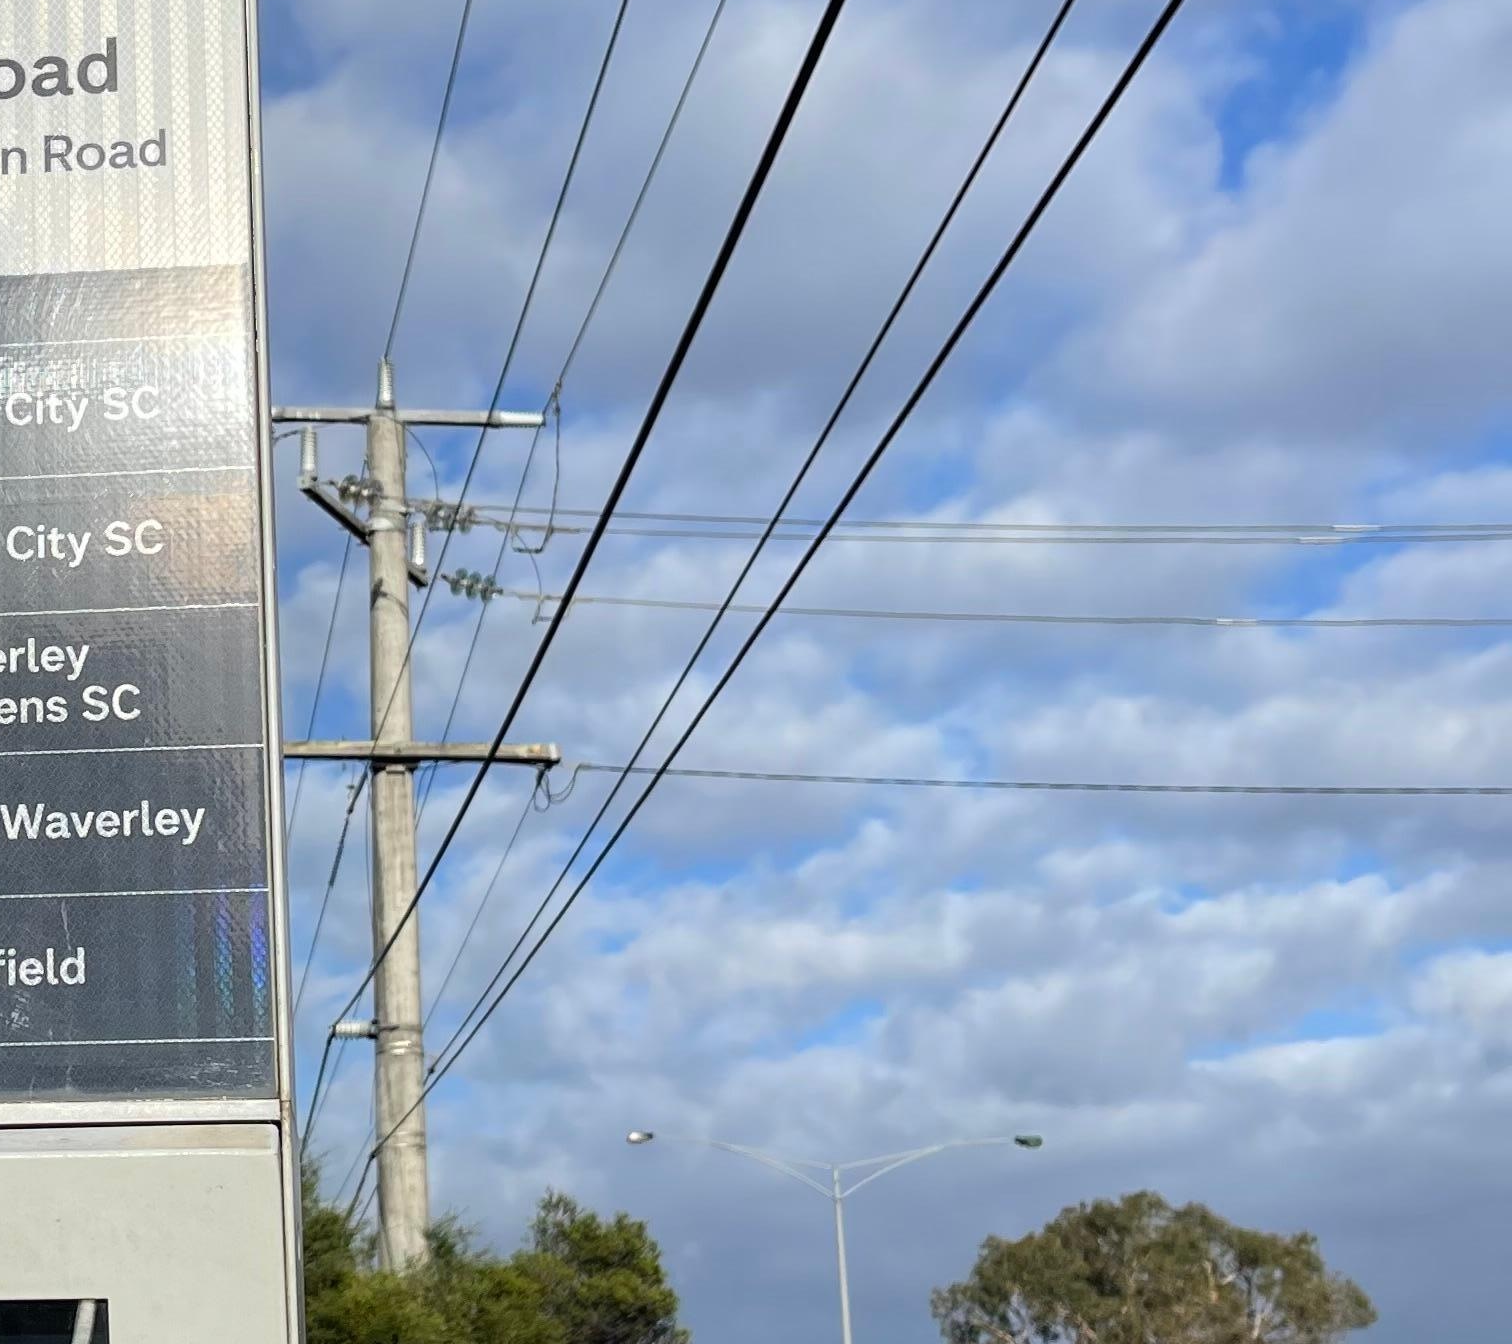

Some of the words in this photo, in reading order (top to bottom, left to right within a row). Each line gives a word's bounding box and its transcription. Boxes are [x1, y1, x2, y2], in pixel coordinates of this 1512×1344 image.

[44, 130, 168, 172] Road
[5, 391, 87, 433] City
[105, 388, 161, 422] SC
[5, 526, 90, 568] City
[105, 521, 164, 557] SC
[81, 685, 141, 722] SC
[0, 802, 205, 845] Waverley
